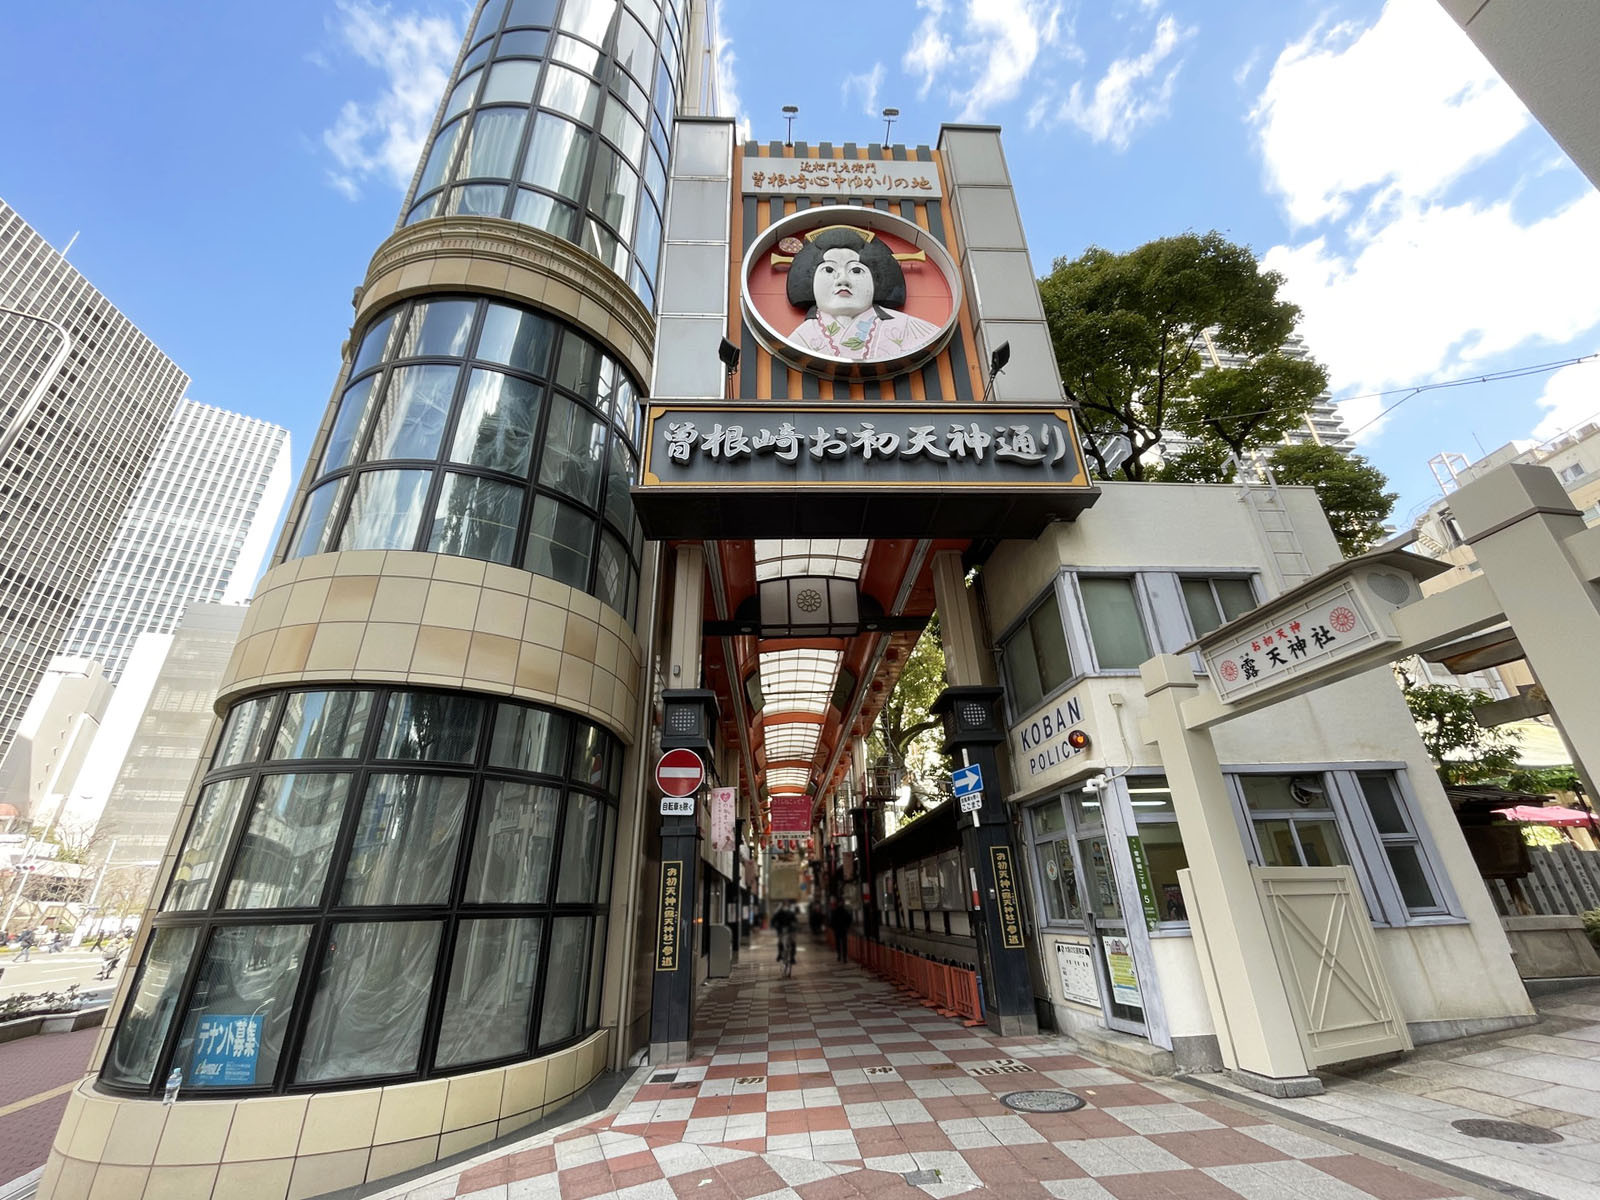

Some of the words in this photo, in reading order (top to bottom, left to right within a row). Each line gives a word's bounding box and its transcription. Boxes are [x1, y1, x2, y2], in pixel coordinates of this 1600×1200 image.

[664, 422, 1067, 467] 曽根崎お初天神通り
[1240, 625, 1336, 681] 露天神社
[1251, 621, 1301, 652] お初天神
[1020, 696, 1081, 752] KOBAN
[662, 802, 693, 811] 自転車を除く
[1143, 895, 1150, 903] 5
[197, 1018, 258, 1058] テナント募集
